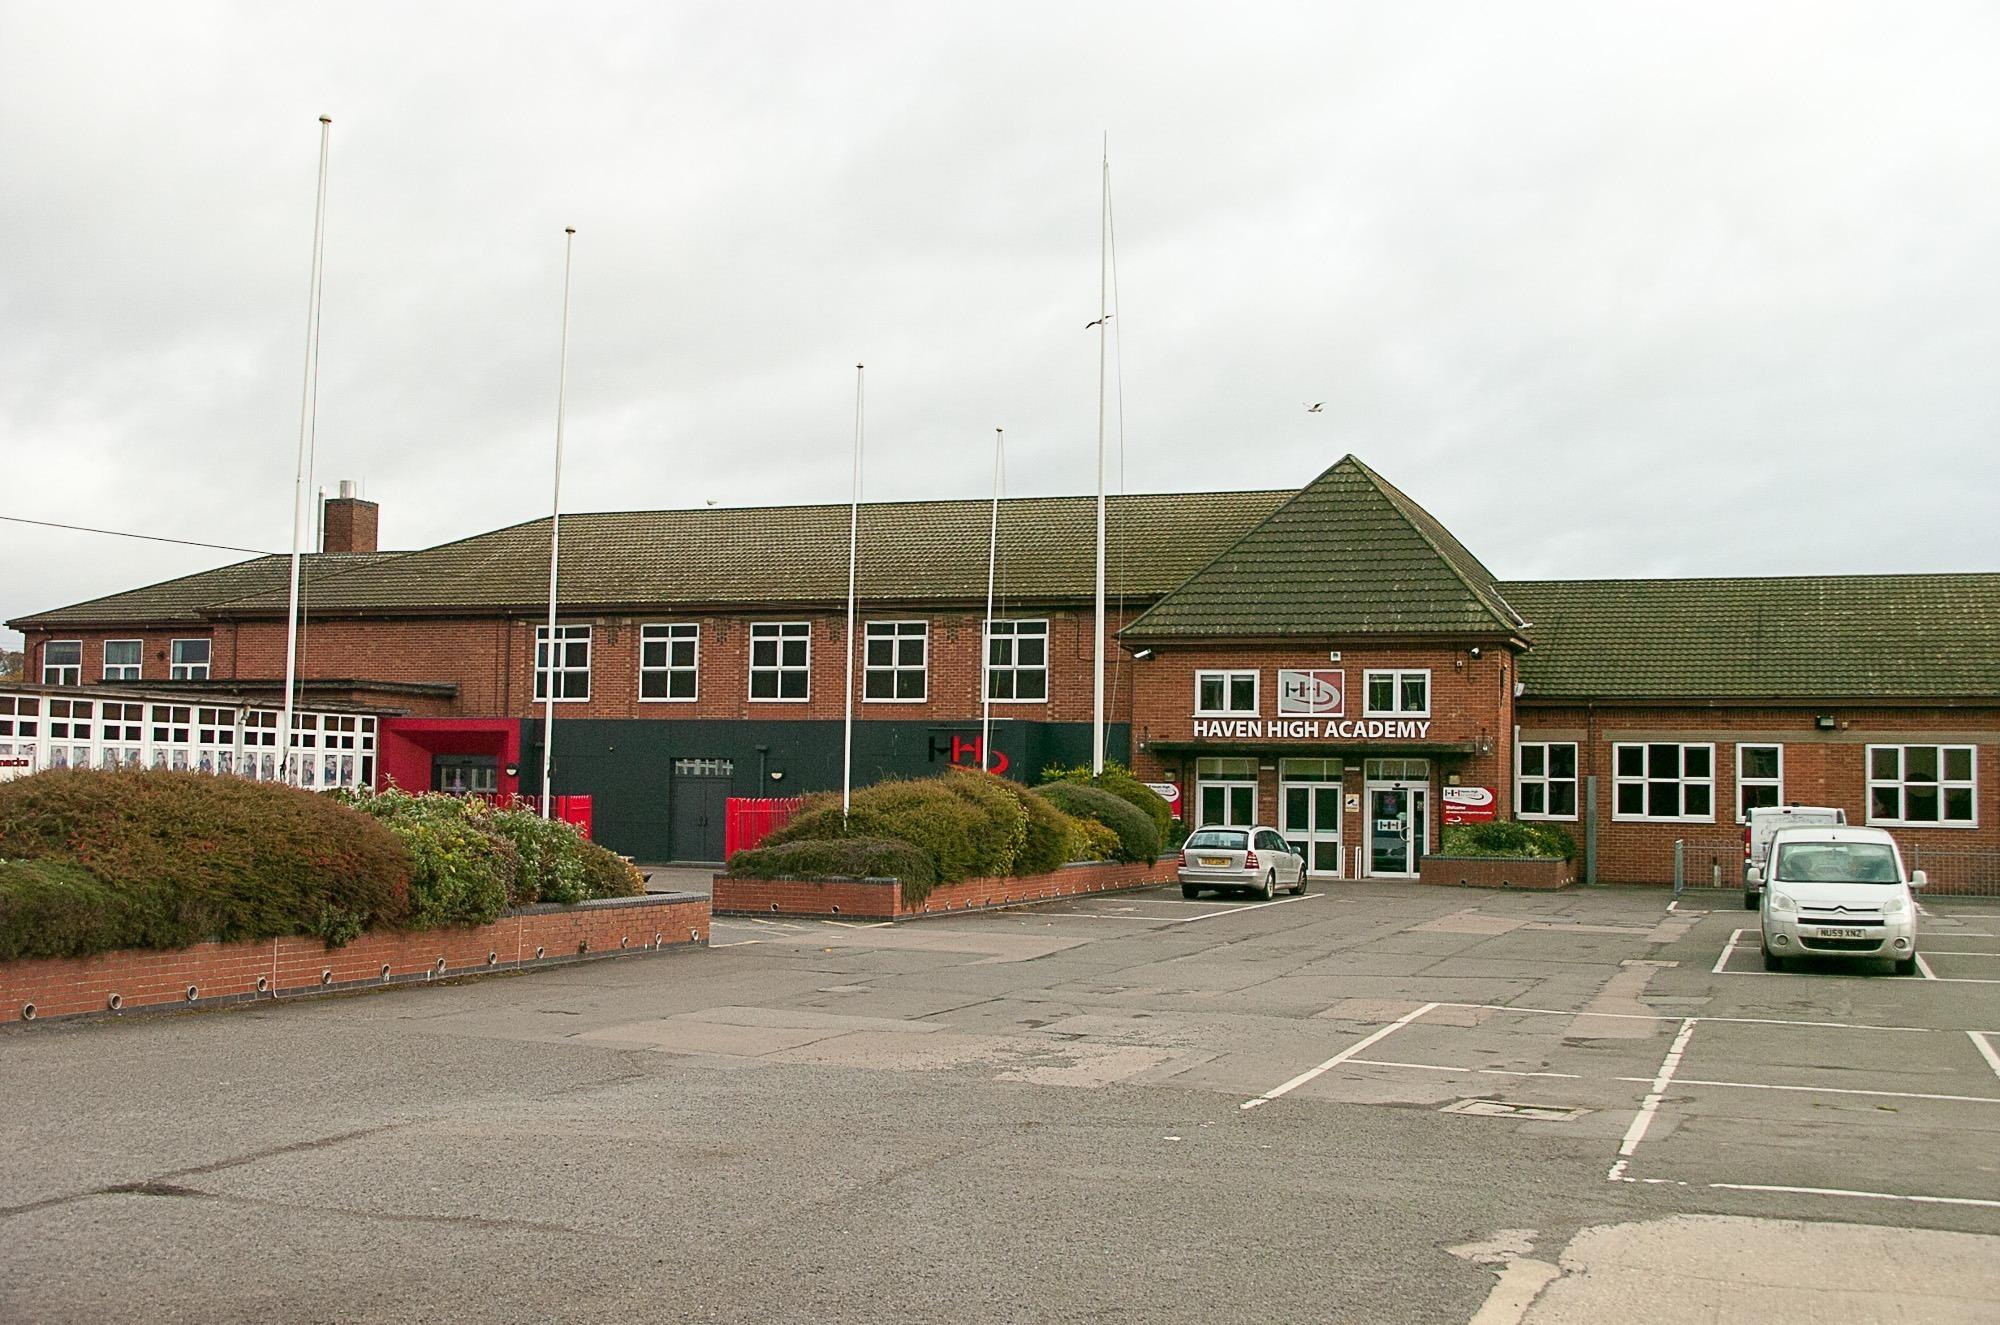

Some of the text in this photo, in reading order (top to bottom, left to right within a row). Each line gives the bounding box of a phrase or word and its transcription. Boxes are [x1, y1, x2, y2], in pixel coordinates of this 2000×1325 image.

[1193, 720, 1431, 738] HAVEN HIGH ACADEMY
